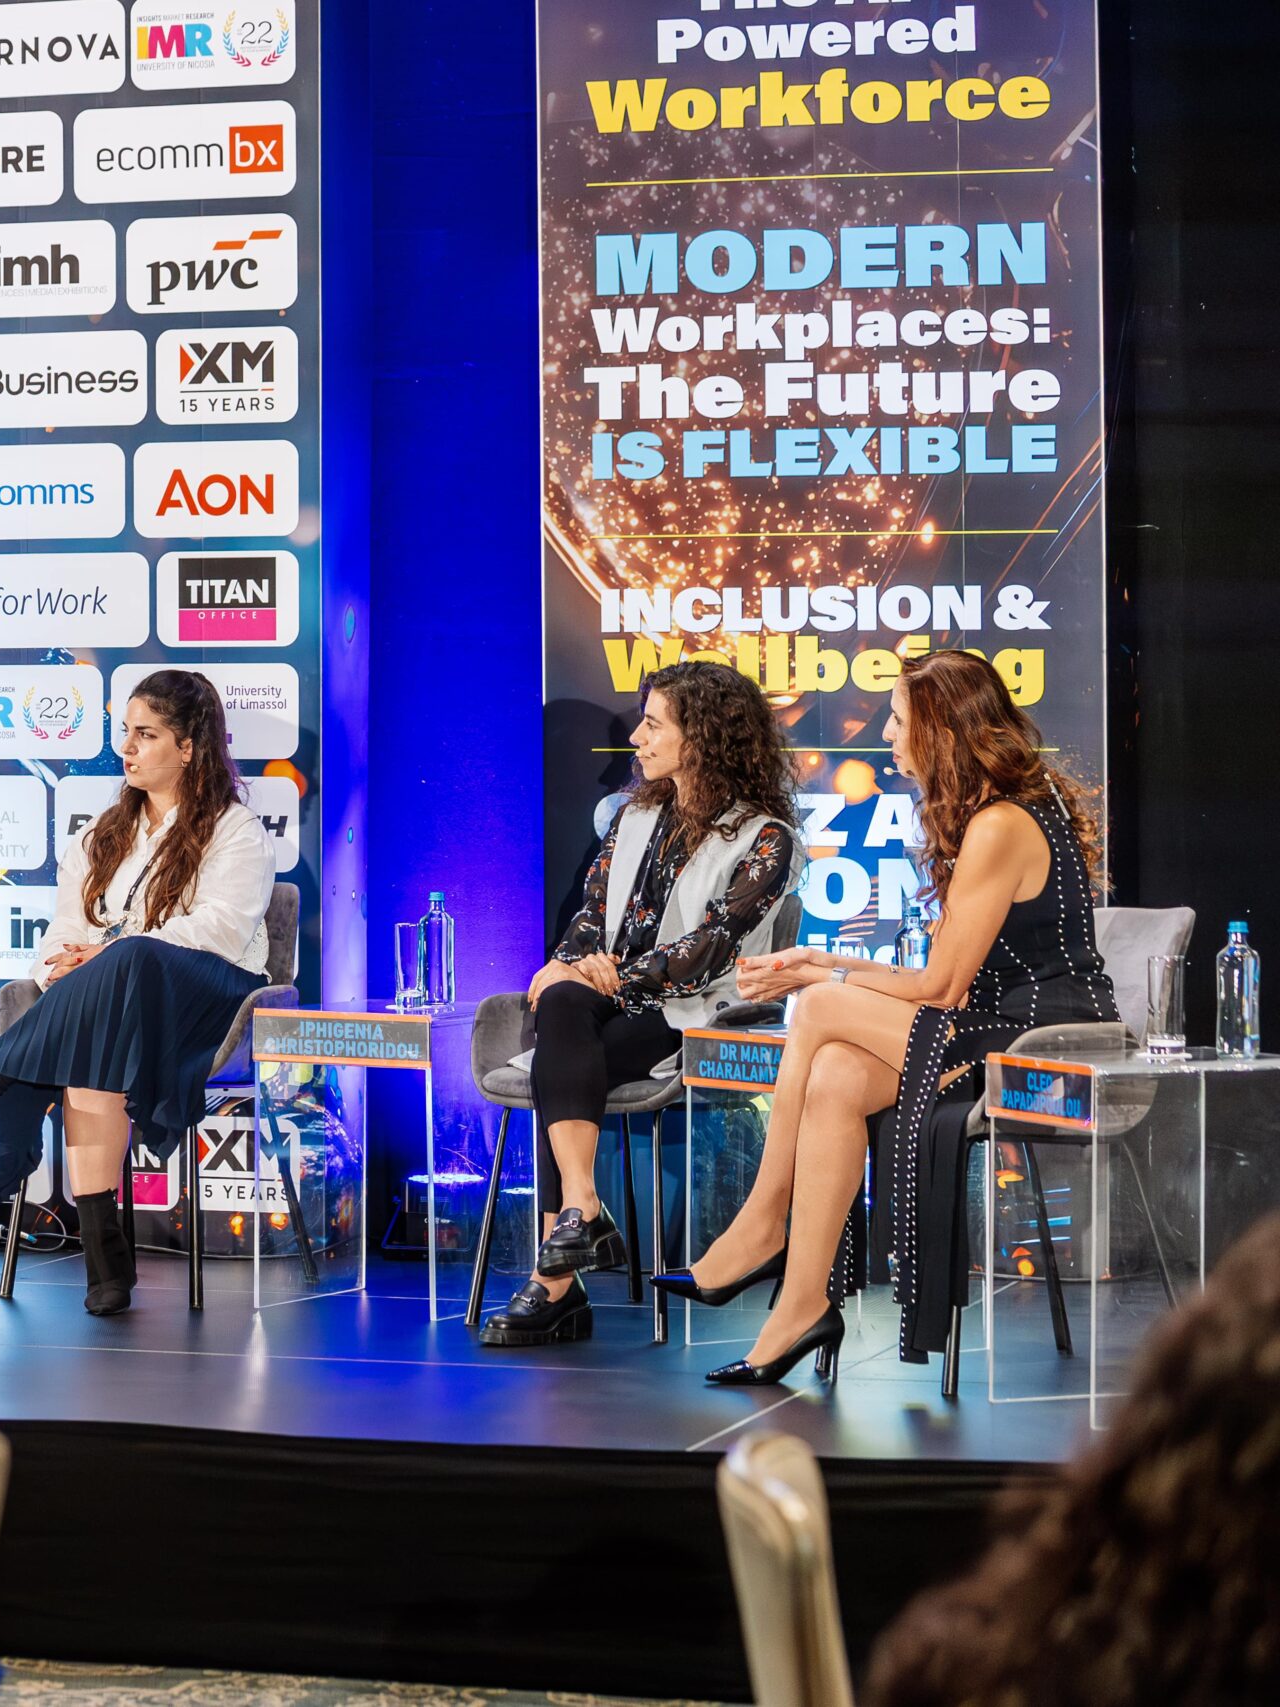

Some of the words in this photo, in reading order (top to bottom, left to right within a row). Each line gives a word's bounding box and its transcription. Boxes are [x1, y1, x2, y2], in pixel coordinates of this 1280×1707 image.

[137, 14, 162, 23] INSIGHTS
[186, 12, 215, 21] RESEARCH
[137, 23, 213, 60] IMR
[241, 21, 273, 45] 22
[656, 5, 976, 64] Powered
[137, 61, 176, 72] UNIVERSITY
[177, 60, 187, 70] OF
[187, 59, 215, 69] NICOSIA
[586, 68, 1051, 134] Workforce
[595, 221, 1046, 296] MODERN
[146, 257, 259, 306] pwc
[590, 300, 1051, 361] Workplaces:
[180, 341, 274, 384] XM
[179, 398, 198, 412] 15
[208, 396, 275, 411] YEARS
[584, 363, 744, 420] The
[765, 360, 1061, 418] Future
[591, 430, 665, 481] IS
[682, 424, 1058, 478] FLEXIBLE
[155, 469, 274, 516] AON
[35, 585, 108, 615] Work
[186, 577, 269, 605] TITAN
[198, 610, 258, 620] OFFICE
[601, 584, 982, 633] INCLUSION
[993, 584, 1052, 632] &
[602, 635, 1046, 707] Wllbeg
[226, 685, 282, 699] University
[226, 699, 237, 710] of
[239, 698, 287, 710] Limassol
[39, 697, 69, 719] 22
[299, 1021, 384, 1041] IPHIGENIA
[264, 1037, 420, 1060] CHRISTOPHORIDOU
[720, 1042, 738, 1062] DR
[741, 1045, 782, 1065] MARIA
[699, 1060, 778, 1083] CHARALAMP
[225, 1185, 288, 1201] YEARS
